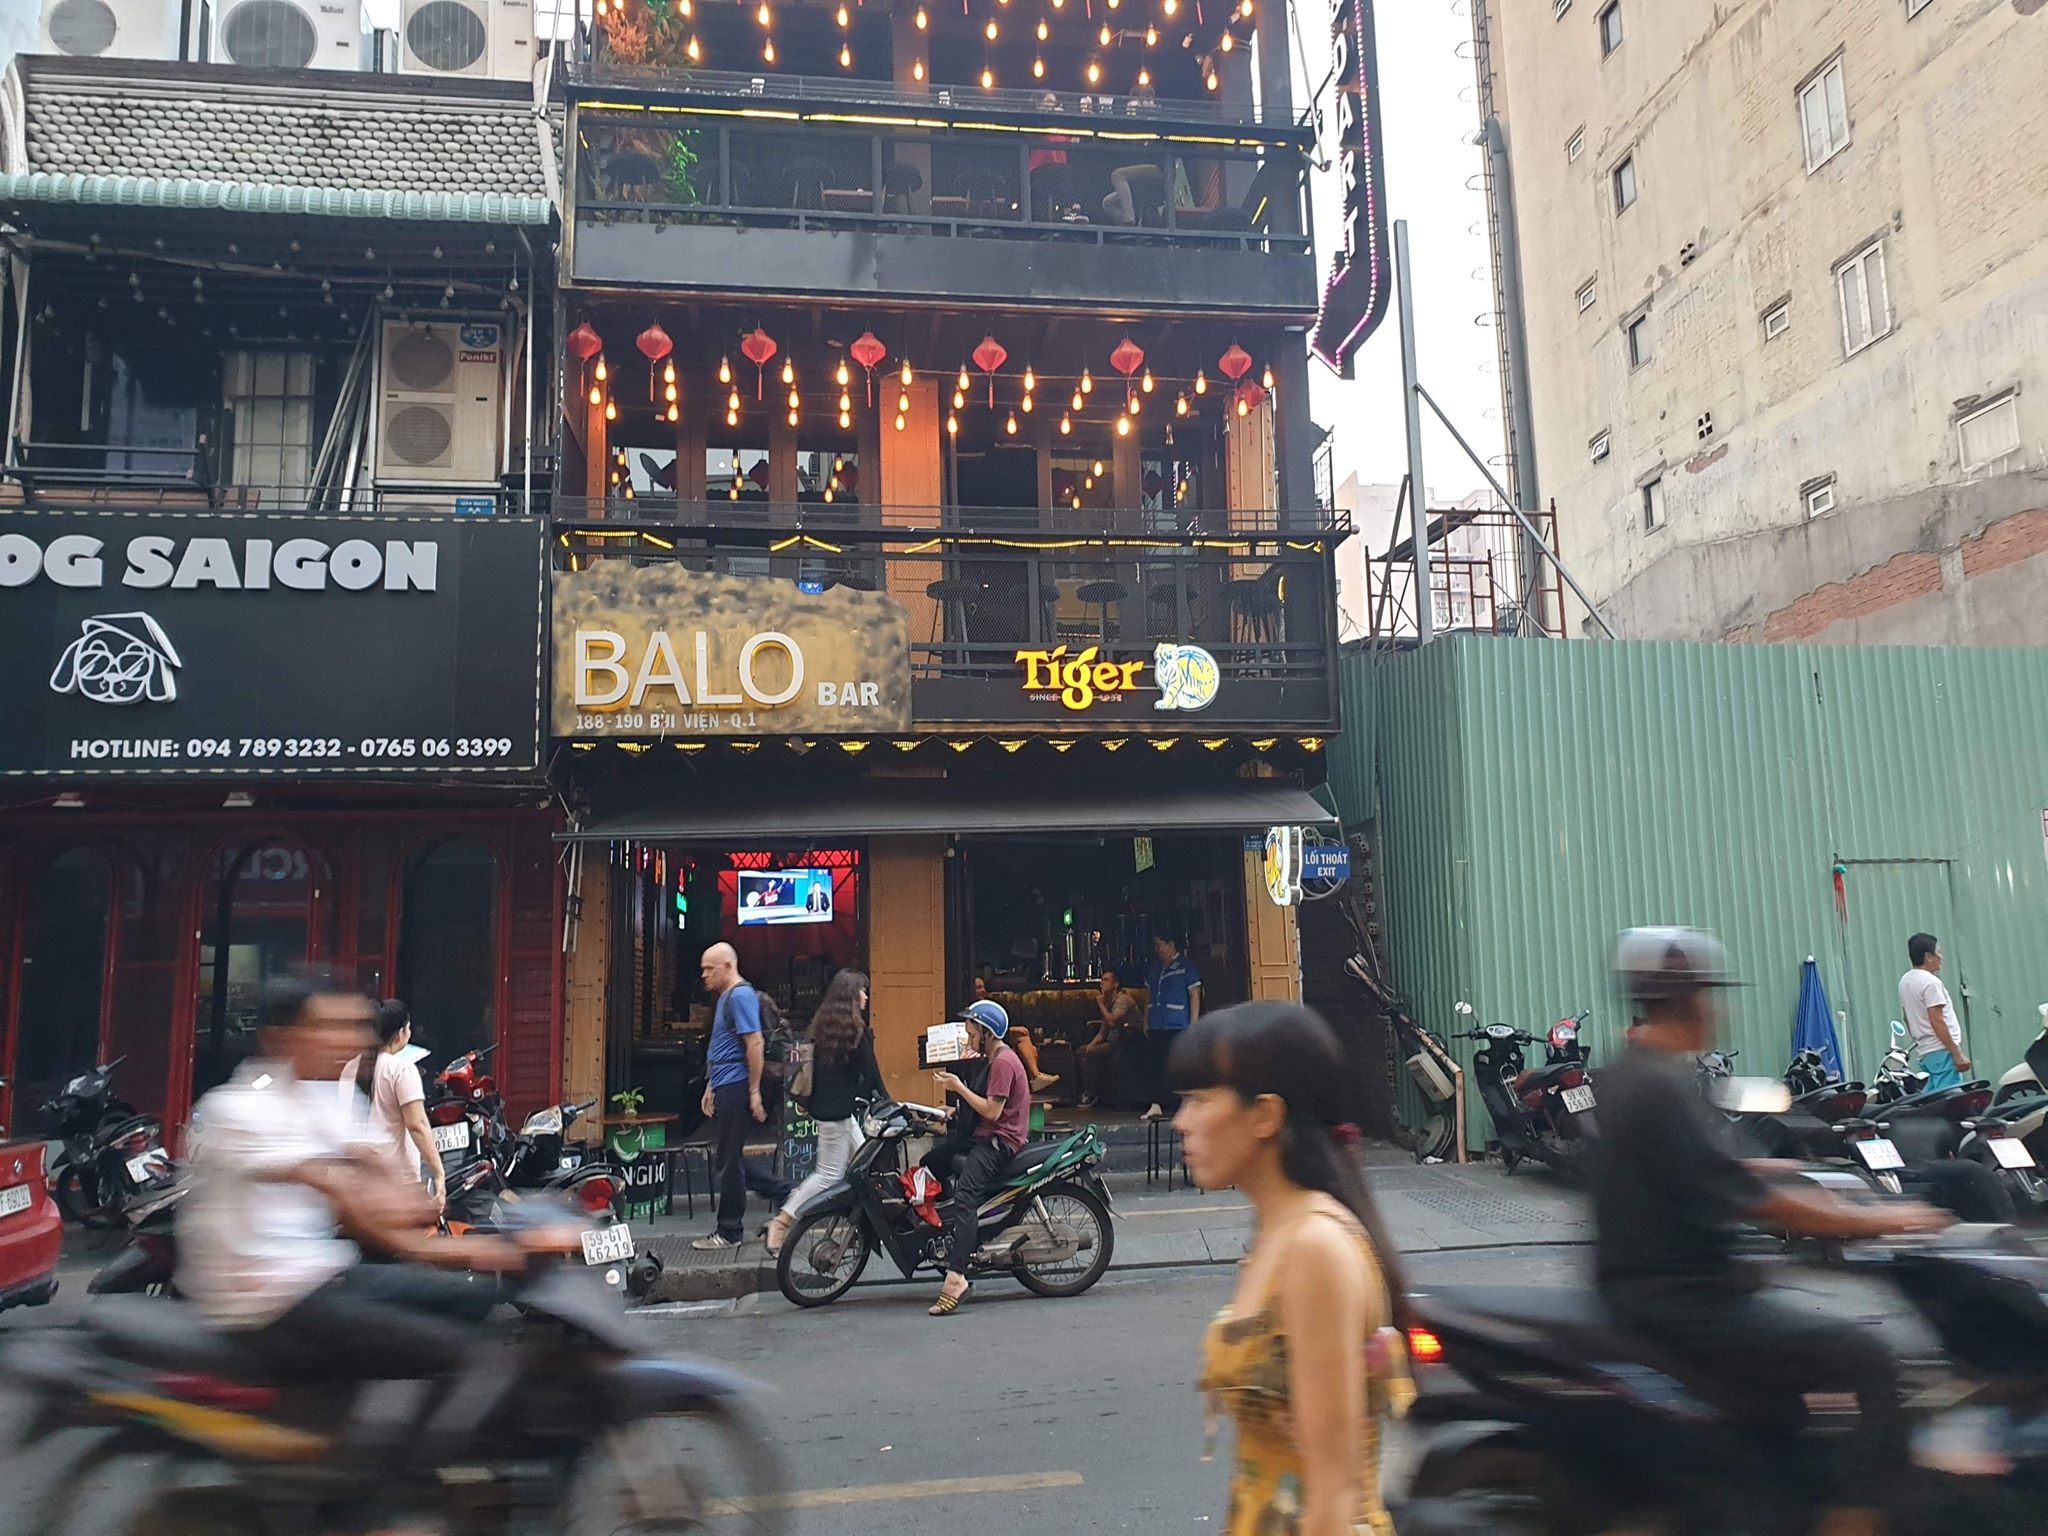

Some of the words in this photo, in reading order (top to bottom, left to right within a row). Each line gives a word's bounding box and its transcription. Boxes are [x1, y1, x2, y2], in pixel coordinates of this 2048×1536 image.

[0, 534, 104, 587] OG
[122, 535, 438, 592] SAIGON
[575, 631, 805, 706] BALO
[1014, 644, 1145, 710] Tiger
[818, 682, 879, 706] BAR
[70, 739, 180, 758] HOTLINE:
[186, 739, 232, 758] 094
[360, 738, 416, 757] 0765
[422, 738, 450, 757] 06
[456, 738, 512, 757] 3399
[1305, 850, 1319, 865] LỐI
[1321, 851, 1348, 865] THOÁT
[1317, 867, 1336, 877] EXIT
